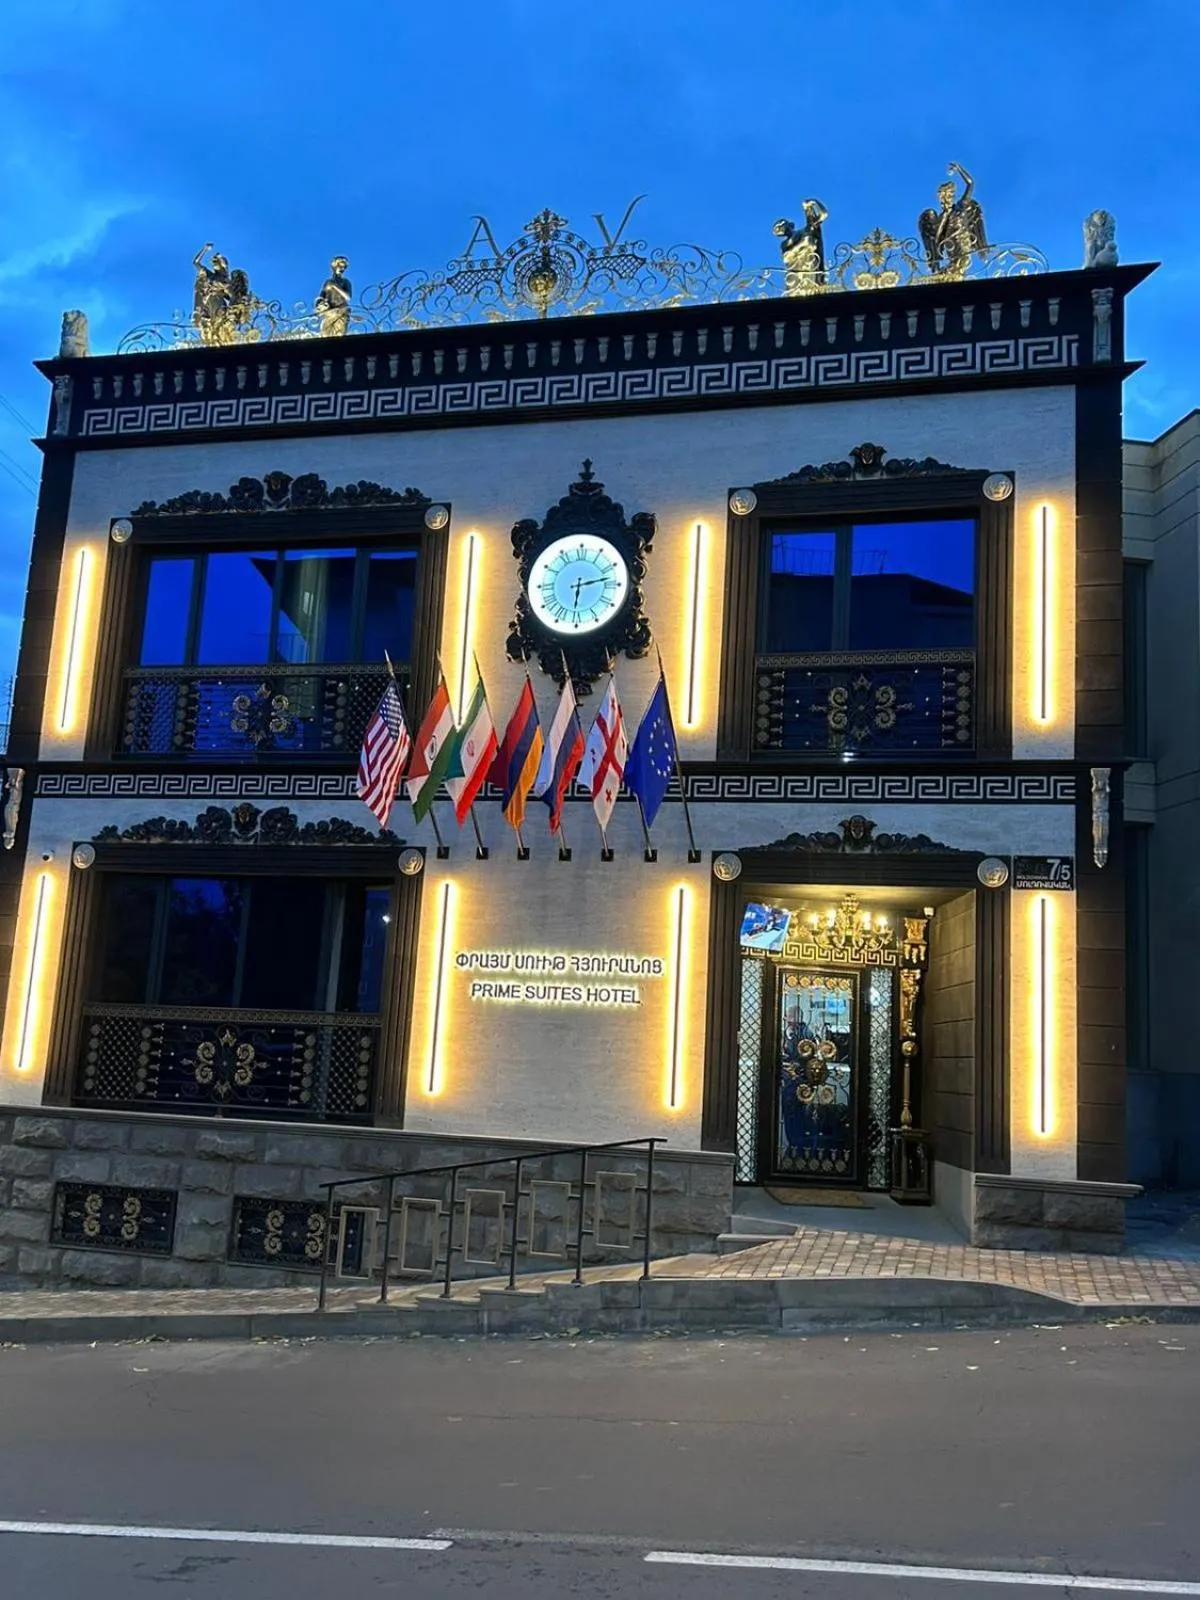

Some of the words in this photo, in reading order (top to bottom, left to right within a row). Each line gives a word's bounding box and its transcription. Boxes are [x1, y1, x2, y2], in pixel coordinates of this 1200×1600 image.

[460, 215, 503, 259] A
[591, 194, 648, 252] V
[1046, 858, 1071, 881] 7/5
[456, 952, 511, 968] ՓՐԱՅՄ
[515, 954, 566, 971] ՍՈՒԻԹ
[571, 956, 663, 974] ՀՅՈՒՐԱՆՈՑ
[471, 983, 521, 999] PRIME
[525, 985, 582, 1001] SUITES
[586, 988, 641, 1004] HOTEL
